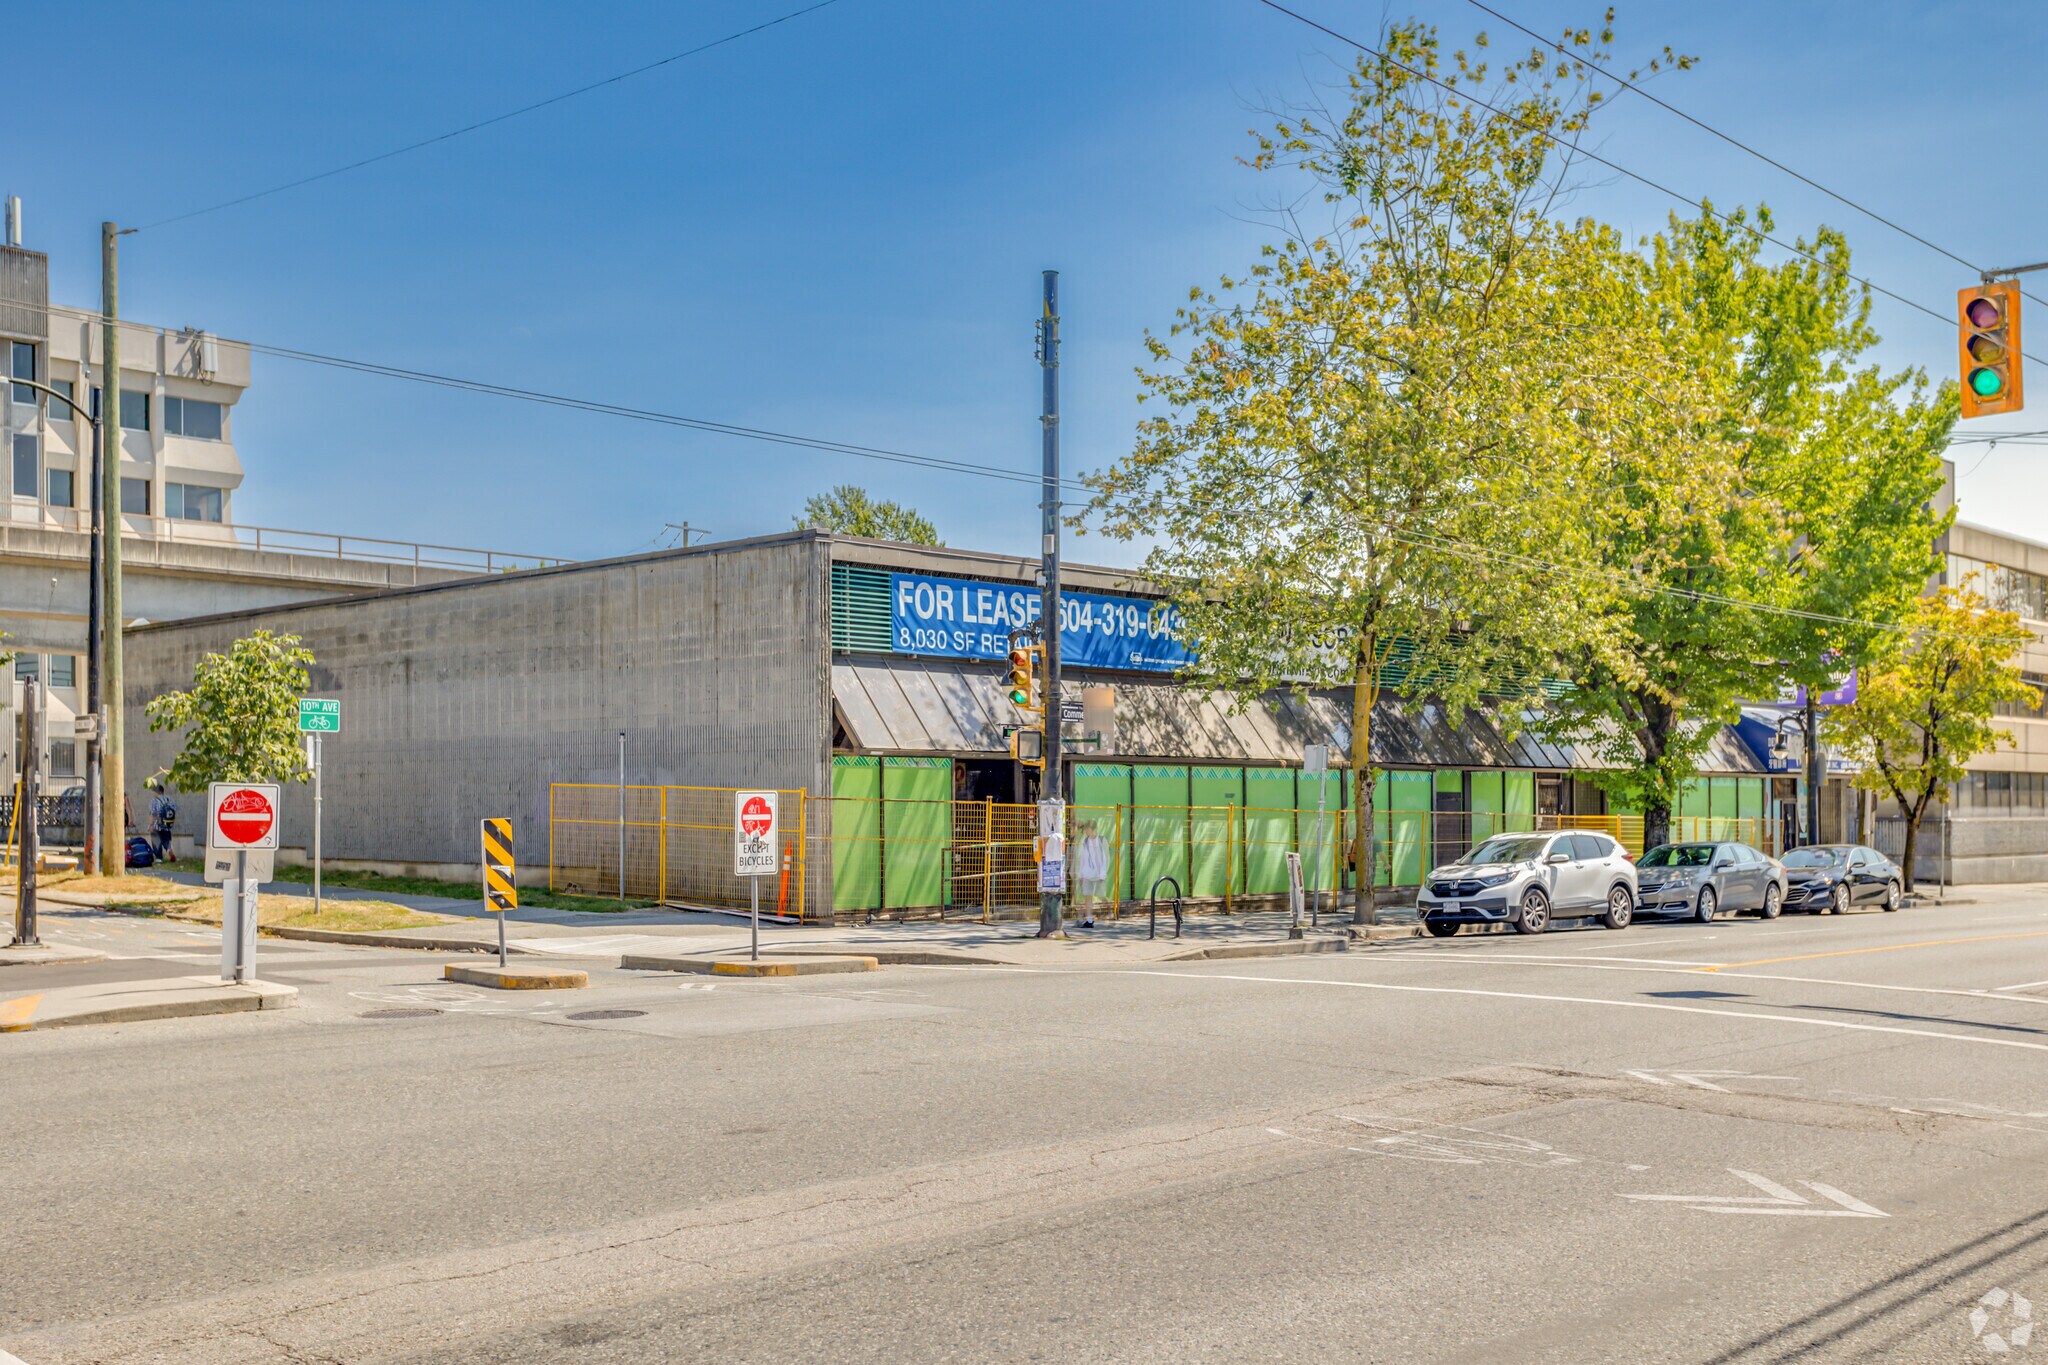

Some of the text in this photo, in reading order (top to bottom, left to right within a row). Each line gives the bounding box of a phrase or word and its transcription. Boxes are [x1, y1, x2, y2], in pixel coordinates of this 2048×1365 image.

[899, 580, 954, 621] FOR
[962, 586, 1041, 628] LEASE
[900, 627, 947, 651] 8,030
[953, 630, 976, 651] SF
[302, 701, 338, 712] 10TH AVE
[739, 856, 774, 867] BICYCLES
